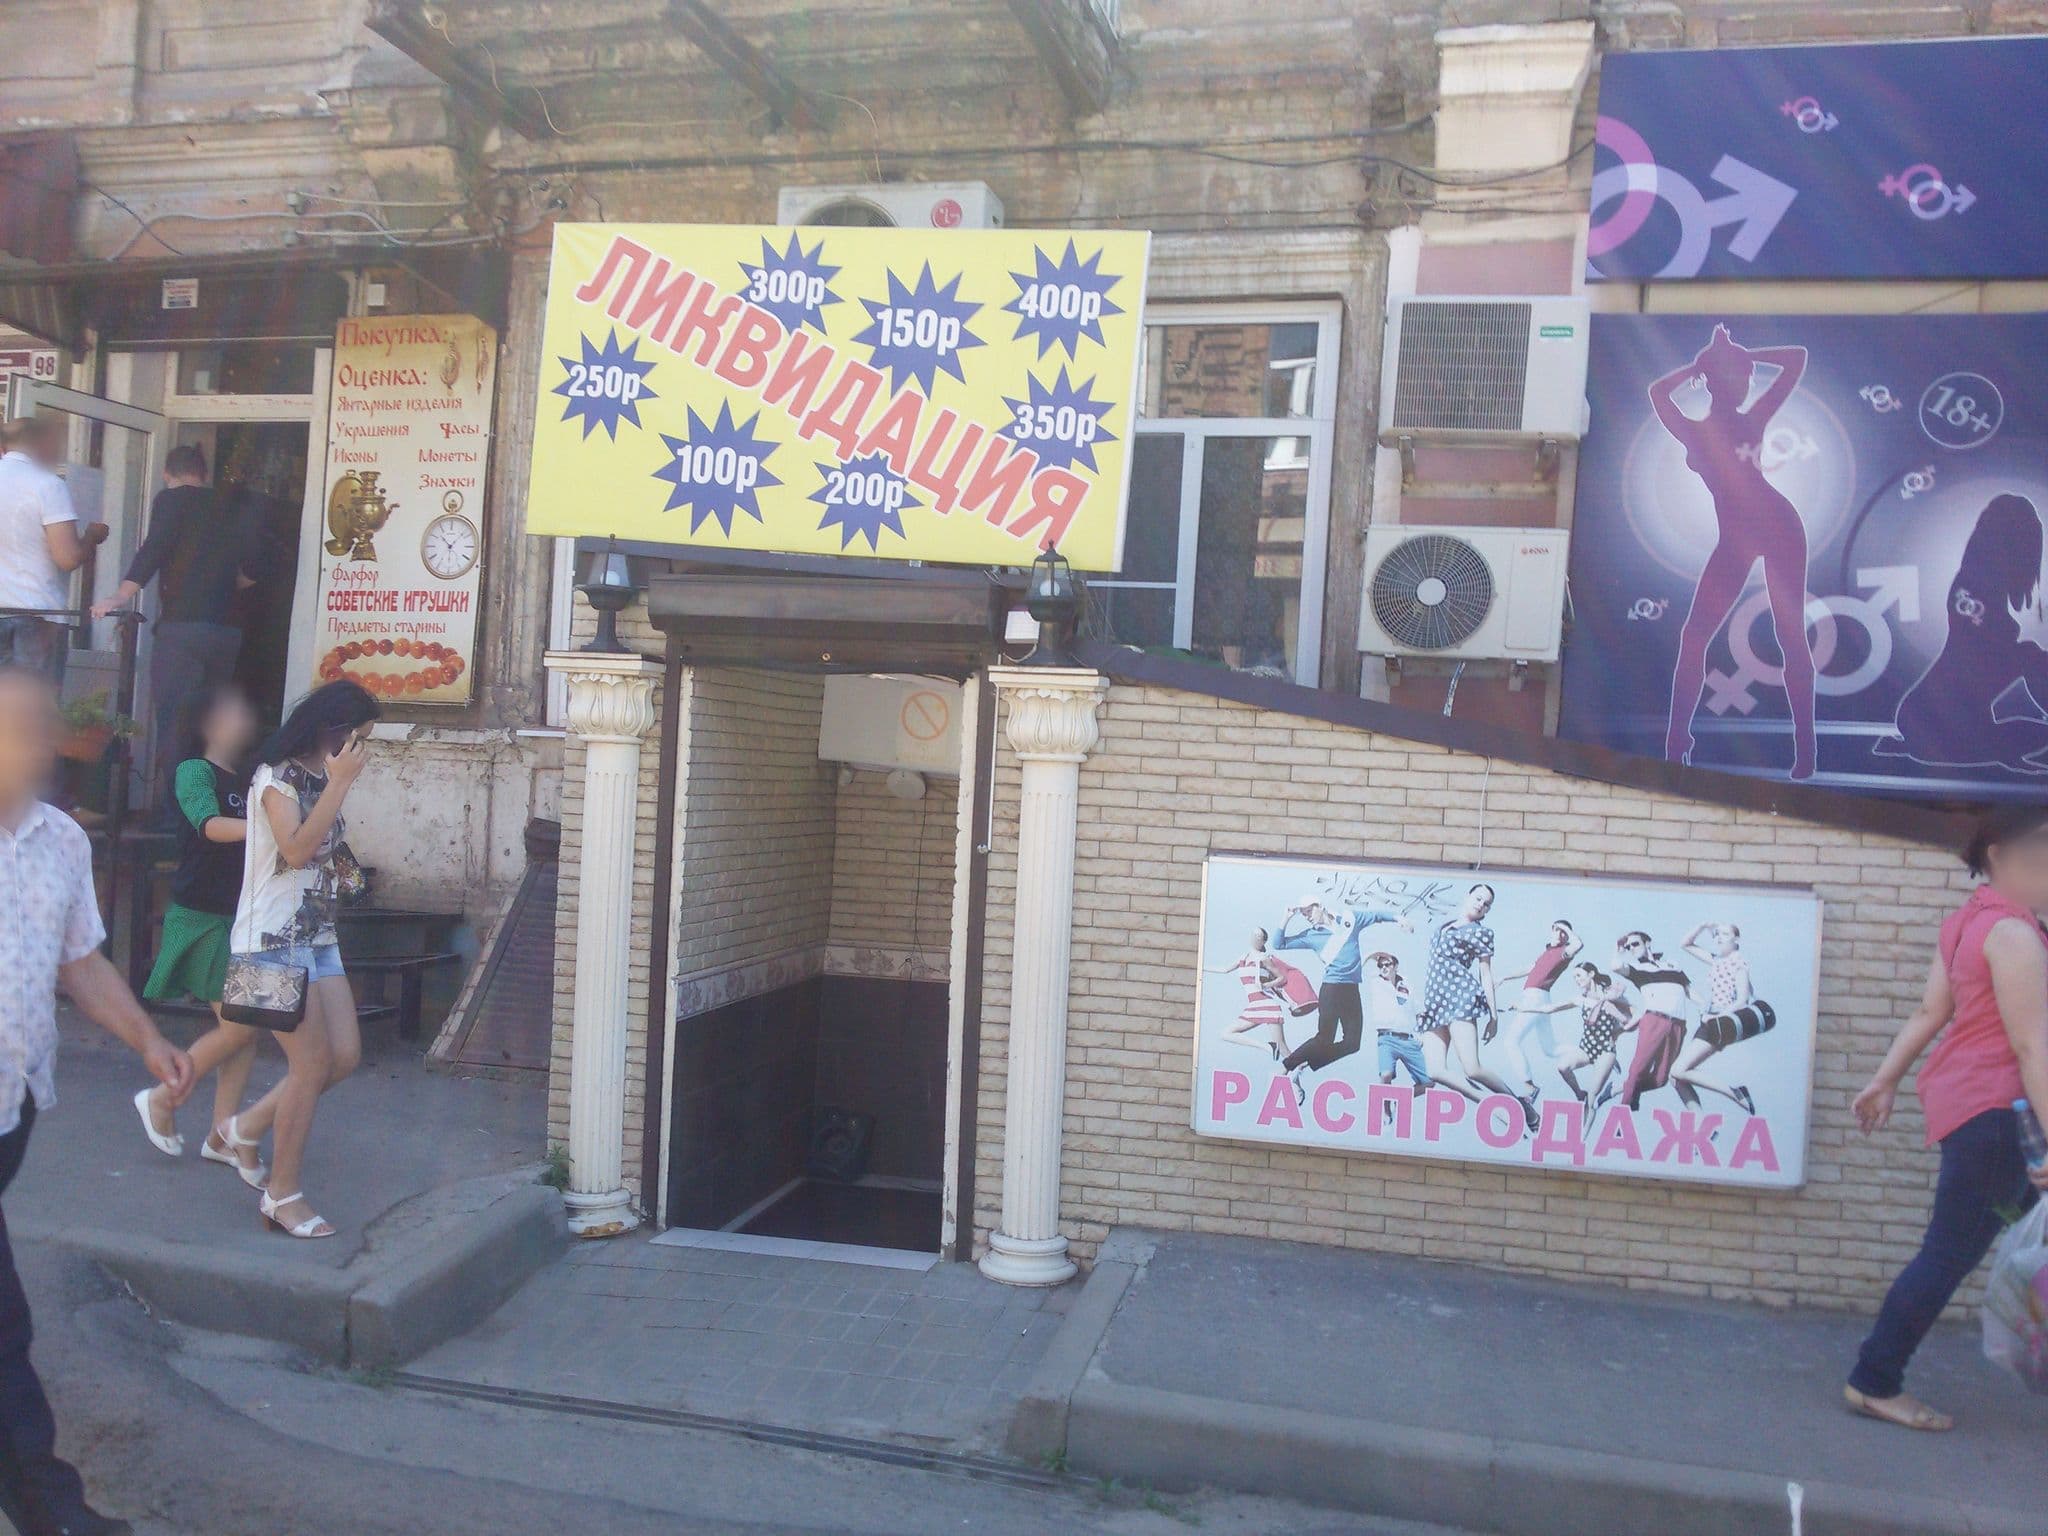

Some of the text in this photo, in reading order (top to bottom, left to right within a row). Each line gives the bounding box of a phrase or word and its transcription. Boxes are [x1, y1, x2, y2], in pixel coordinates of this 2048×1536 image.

[750, 268, 826, 310] 300р
[1018, 284, 1101, 326] 400р
[341, 323, 448, 356] Покупка:
[876, 307, 960, 356] 150р
[34, 356, 55, 376] 98
[338, 363, 428, 391] Оценка:
[567, 364, 641, 405] 250р
[574, 234, 1091, 553] ЛИКВИДАЦИЯ
[337, 396, 463, 416] Янтарные изделия
[1926, 385, 1992, 433] 18+
[336, 421, 410, 444] Украшения
[439, 423, 479, 439] Часы
[1013, 404, 1098, 448] 350р
[334, 448, 378, 464] Иконы
[418, 449, 477, 463] Монеты
[677, 444, 758, 494] 100р
[418, 473, 475, 490] Значки
[825, 471, 905, 513] 200р
[332, 562, 379, 589] Фарфор
[327, 590, 470, 613] СОВЕТСКИЕ ИГРУШКИ
[328, 617, 446, 640] Предметы старины
[1211, 1070, 1781, 1173] РАСПРОДАЖА
